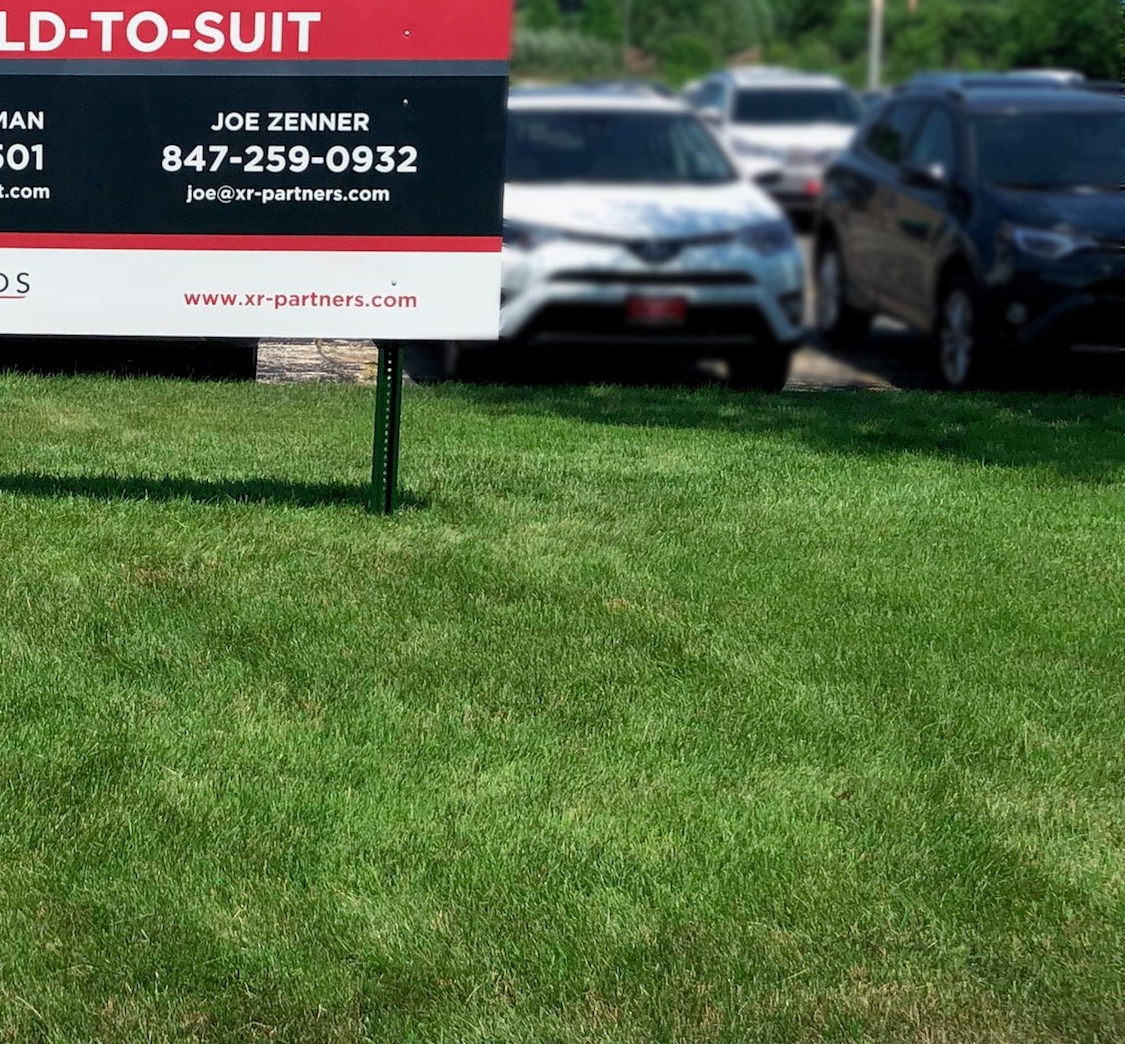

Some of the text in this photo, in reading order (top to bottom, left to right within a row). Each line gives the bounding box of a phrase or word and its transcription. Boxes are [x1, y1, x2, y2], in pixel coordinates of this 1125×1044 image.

[210, 112, 370, 132] JOE ZENNER
[161, 144, 418, 173] 847-259-0932
[185, 184, 390, 204] joe@xr-partners.com
[184, 291, 417, 309] www.xr-partners.com
